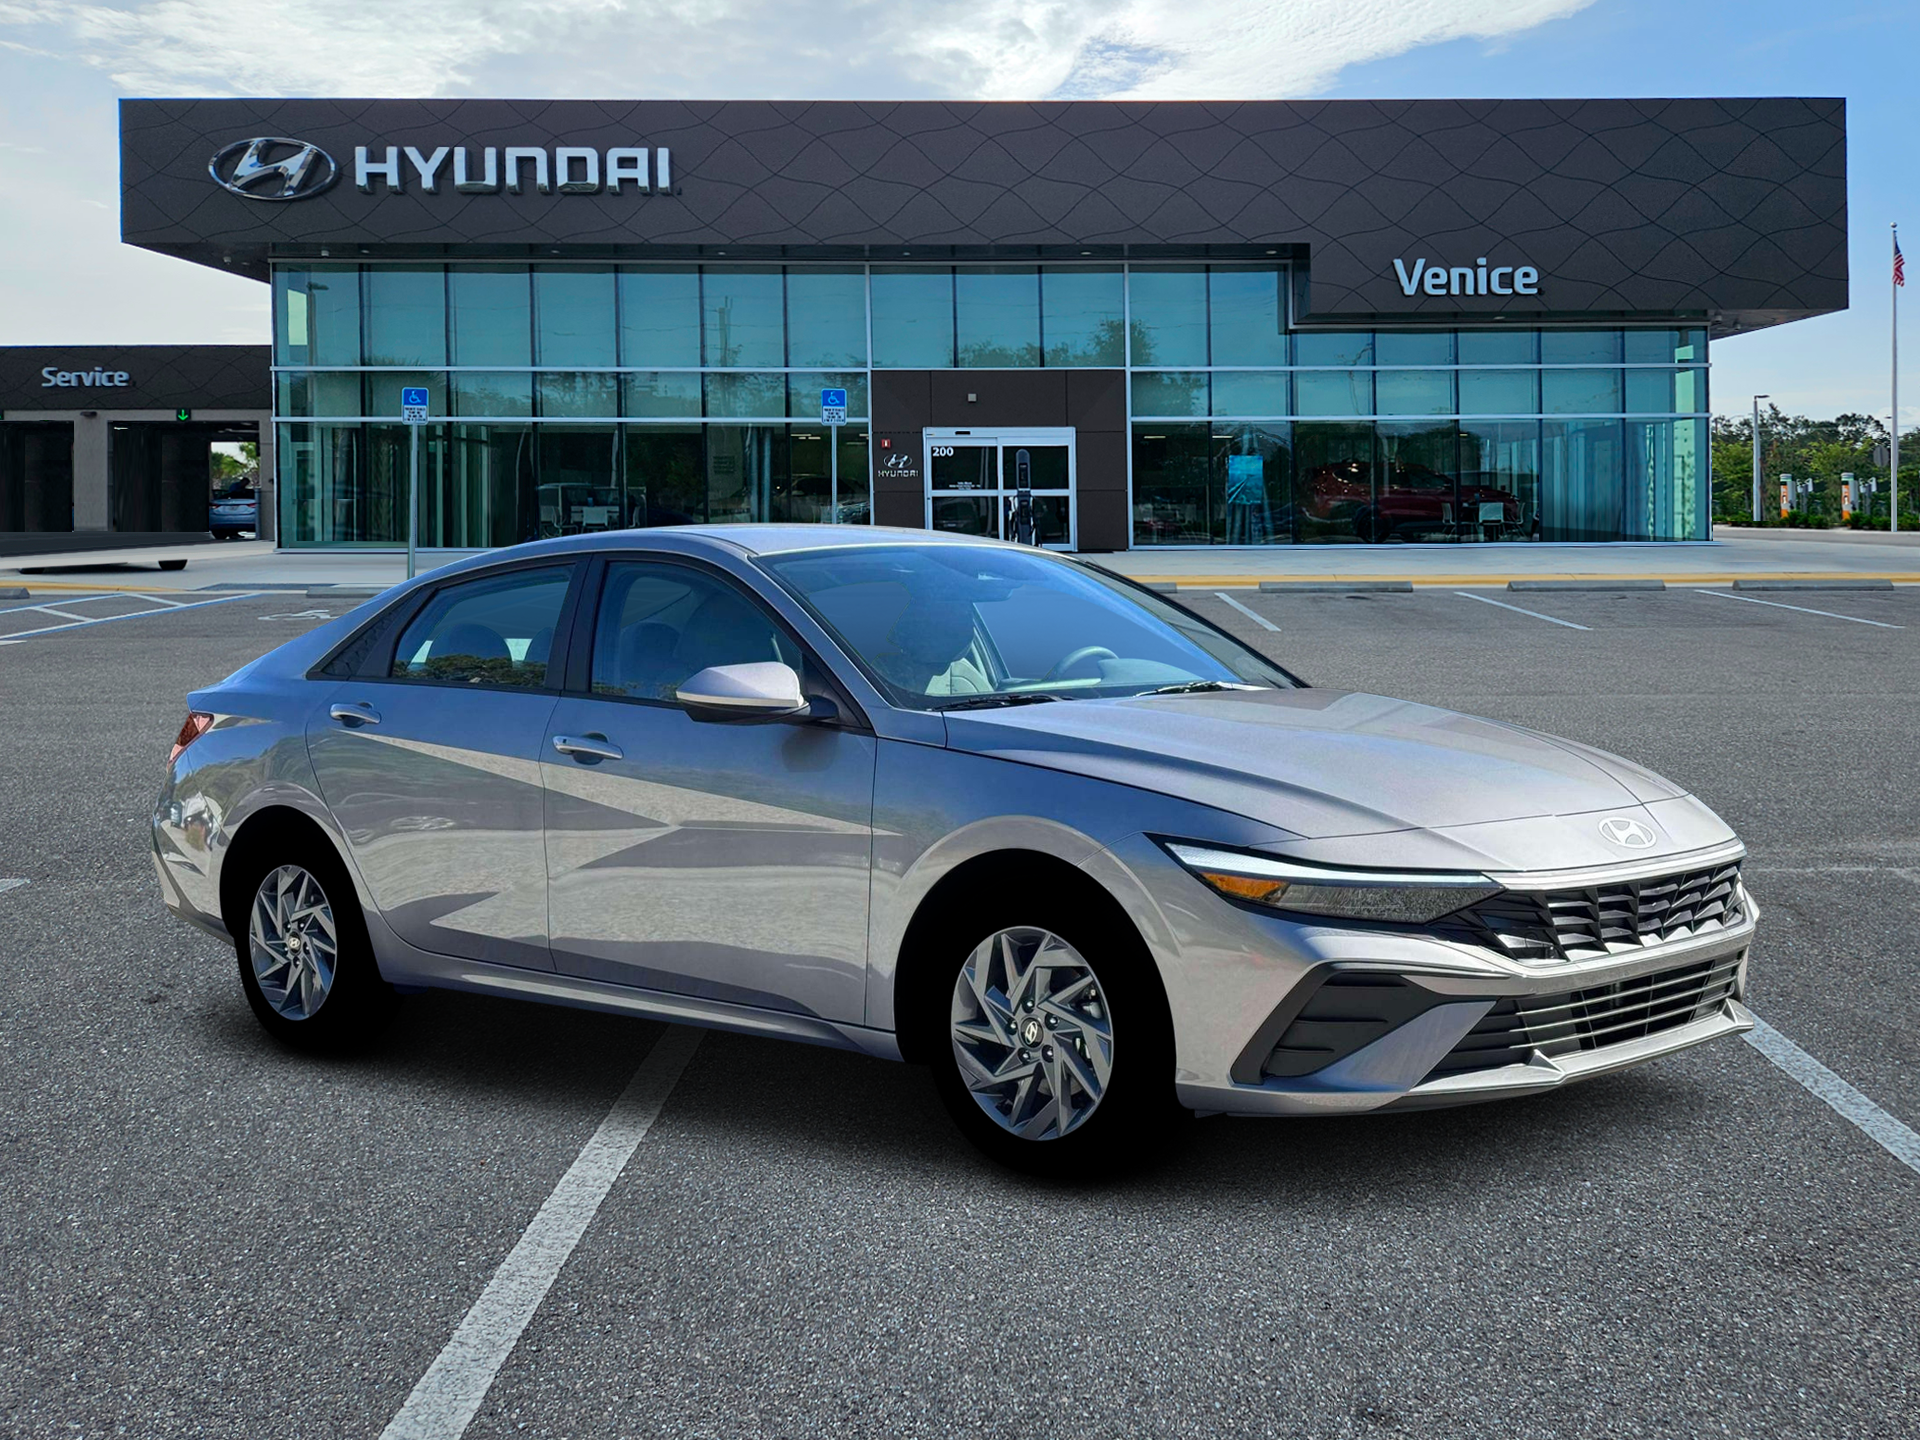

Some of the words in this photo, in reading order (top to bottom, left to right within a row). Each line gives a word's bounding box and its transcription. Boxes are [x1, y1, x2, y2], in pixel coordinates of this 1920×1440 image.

[354, 146, 672, 194] HYUNDAI
[1393, 257, 1537, 296] Venice
[41, 366, 129, 387] Service
[932, 446, 953, 457] 200
